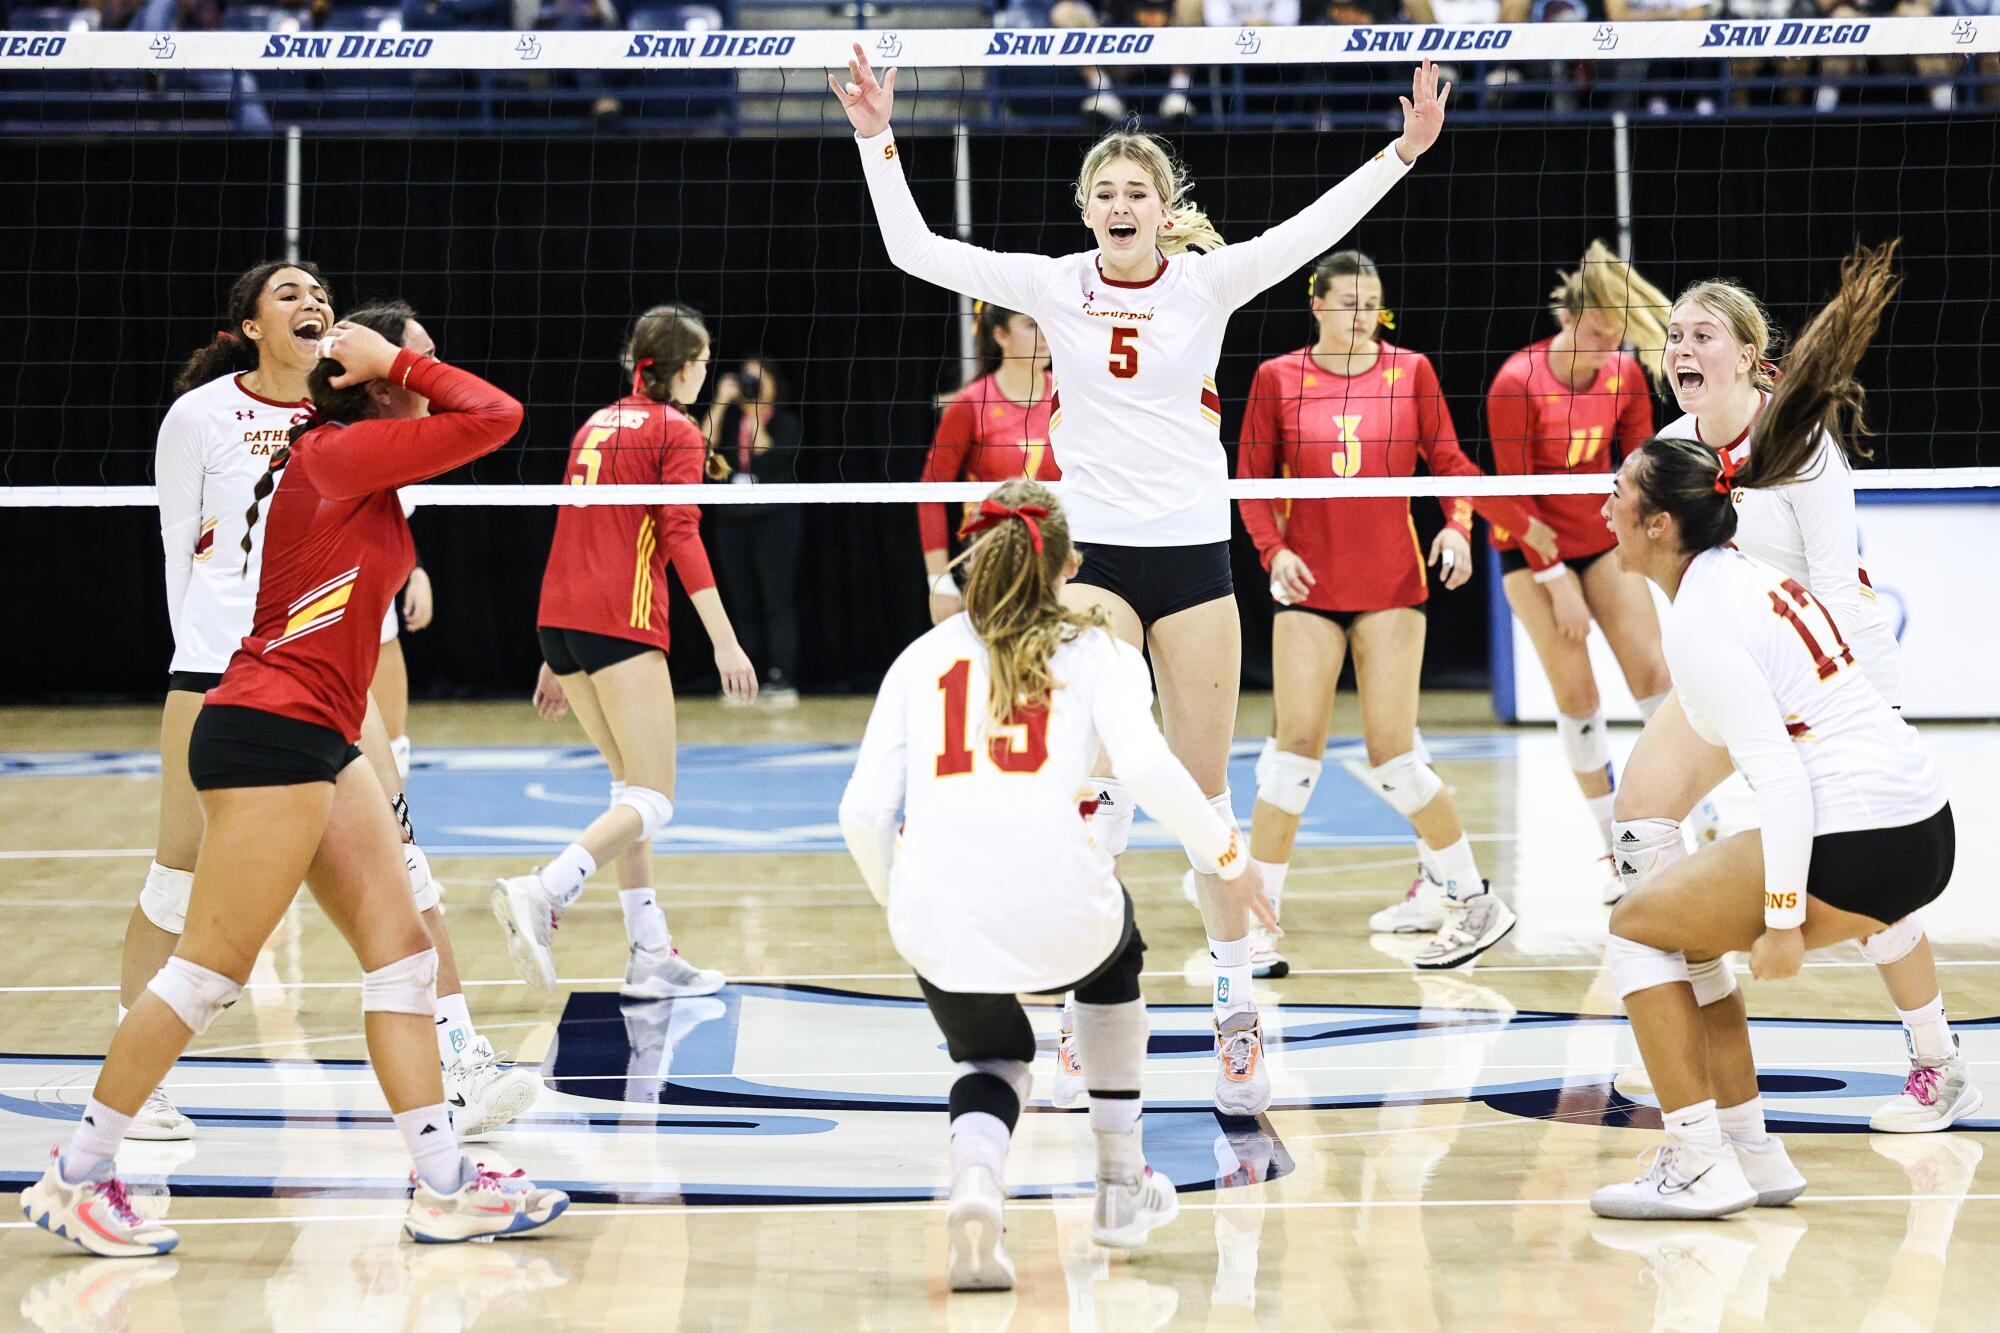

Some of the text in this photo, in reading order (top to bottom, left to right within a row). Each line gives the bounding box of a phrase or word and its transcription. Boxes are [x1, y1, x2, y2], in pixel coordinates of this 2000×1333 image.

[261, 34, 434, 58] SAN DIEGO
[625, 34, 796, 58] SAN DIEGO
[986, 31, 1155, 56] SAN DIEGO
[1343, 27, 1513, 52] SAN DIEGO
[1700, 22, 1871, 47] SAN DIEGO
[1107, 326, 1140, 380] 5
[1331, 414, 1363, 478] 3
[1565, 425, 1604, 469] 11
[570, 427, 618, 507] 5
[1766, 577, 1855, 682] 17
